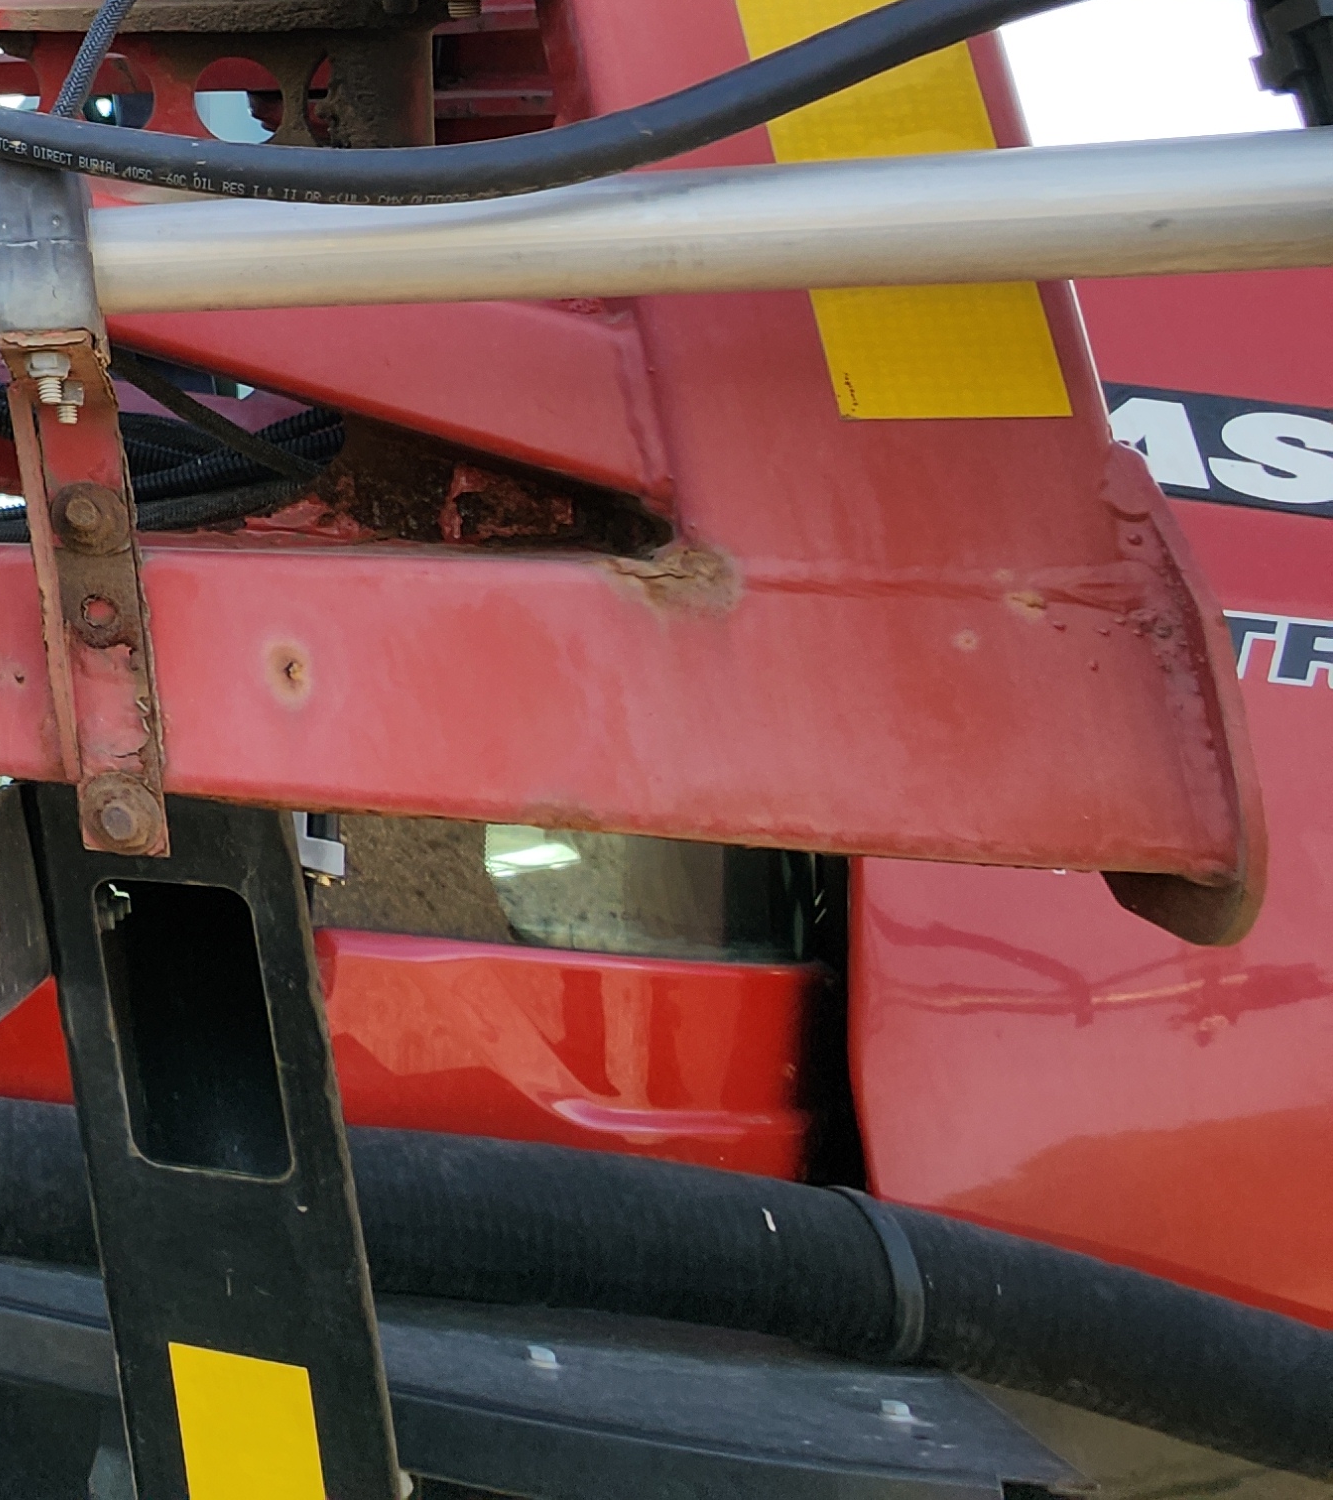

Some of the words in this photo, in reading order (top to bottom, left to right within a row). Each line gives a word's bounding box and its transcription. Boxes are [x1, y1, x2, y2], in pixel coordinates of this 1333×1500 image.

[33, 145, 73, 167] DIRECT
[78, 156, 119, 176] BURIAL
[193, 177, 215, 192] OIL
[222, 181, 245, 195] RES
